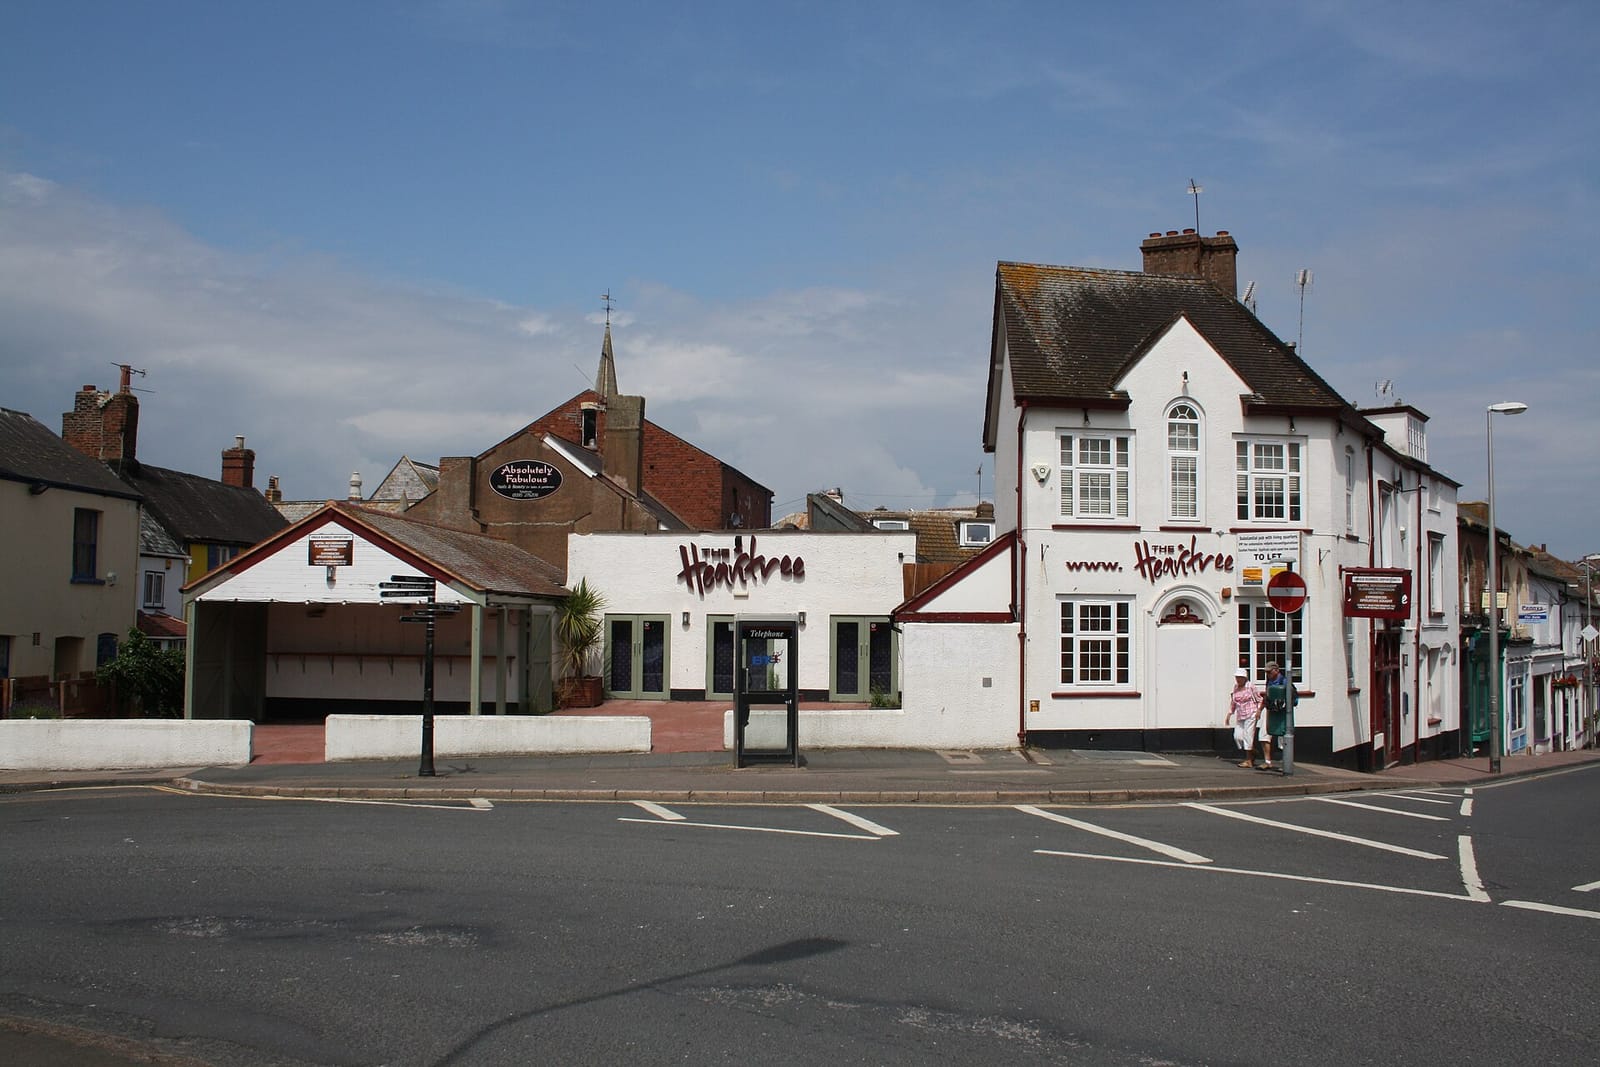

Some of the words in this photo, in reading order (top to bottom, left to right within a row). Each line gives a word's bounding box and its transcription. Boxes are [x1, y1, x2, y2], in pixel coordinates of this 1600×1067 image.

[501, 465, 553, 476] Absolutely
[505, 474, 548, 483] Fabulous
[701, 548, 730, 559] THE
[1151, 545, 1175, 554] THE
[1253, 553, 1265, 561] TO
[1066, 561, 1123, 572] www.
[750, 629, 784, 639] Telephone
